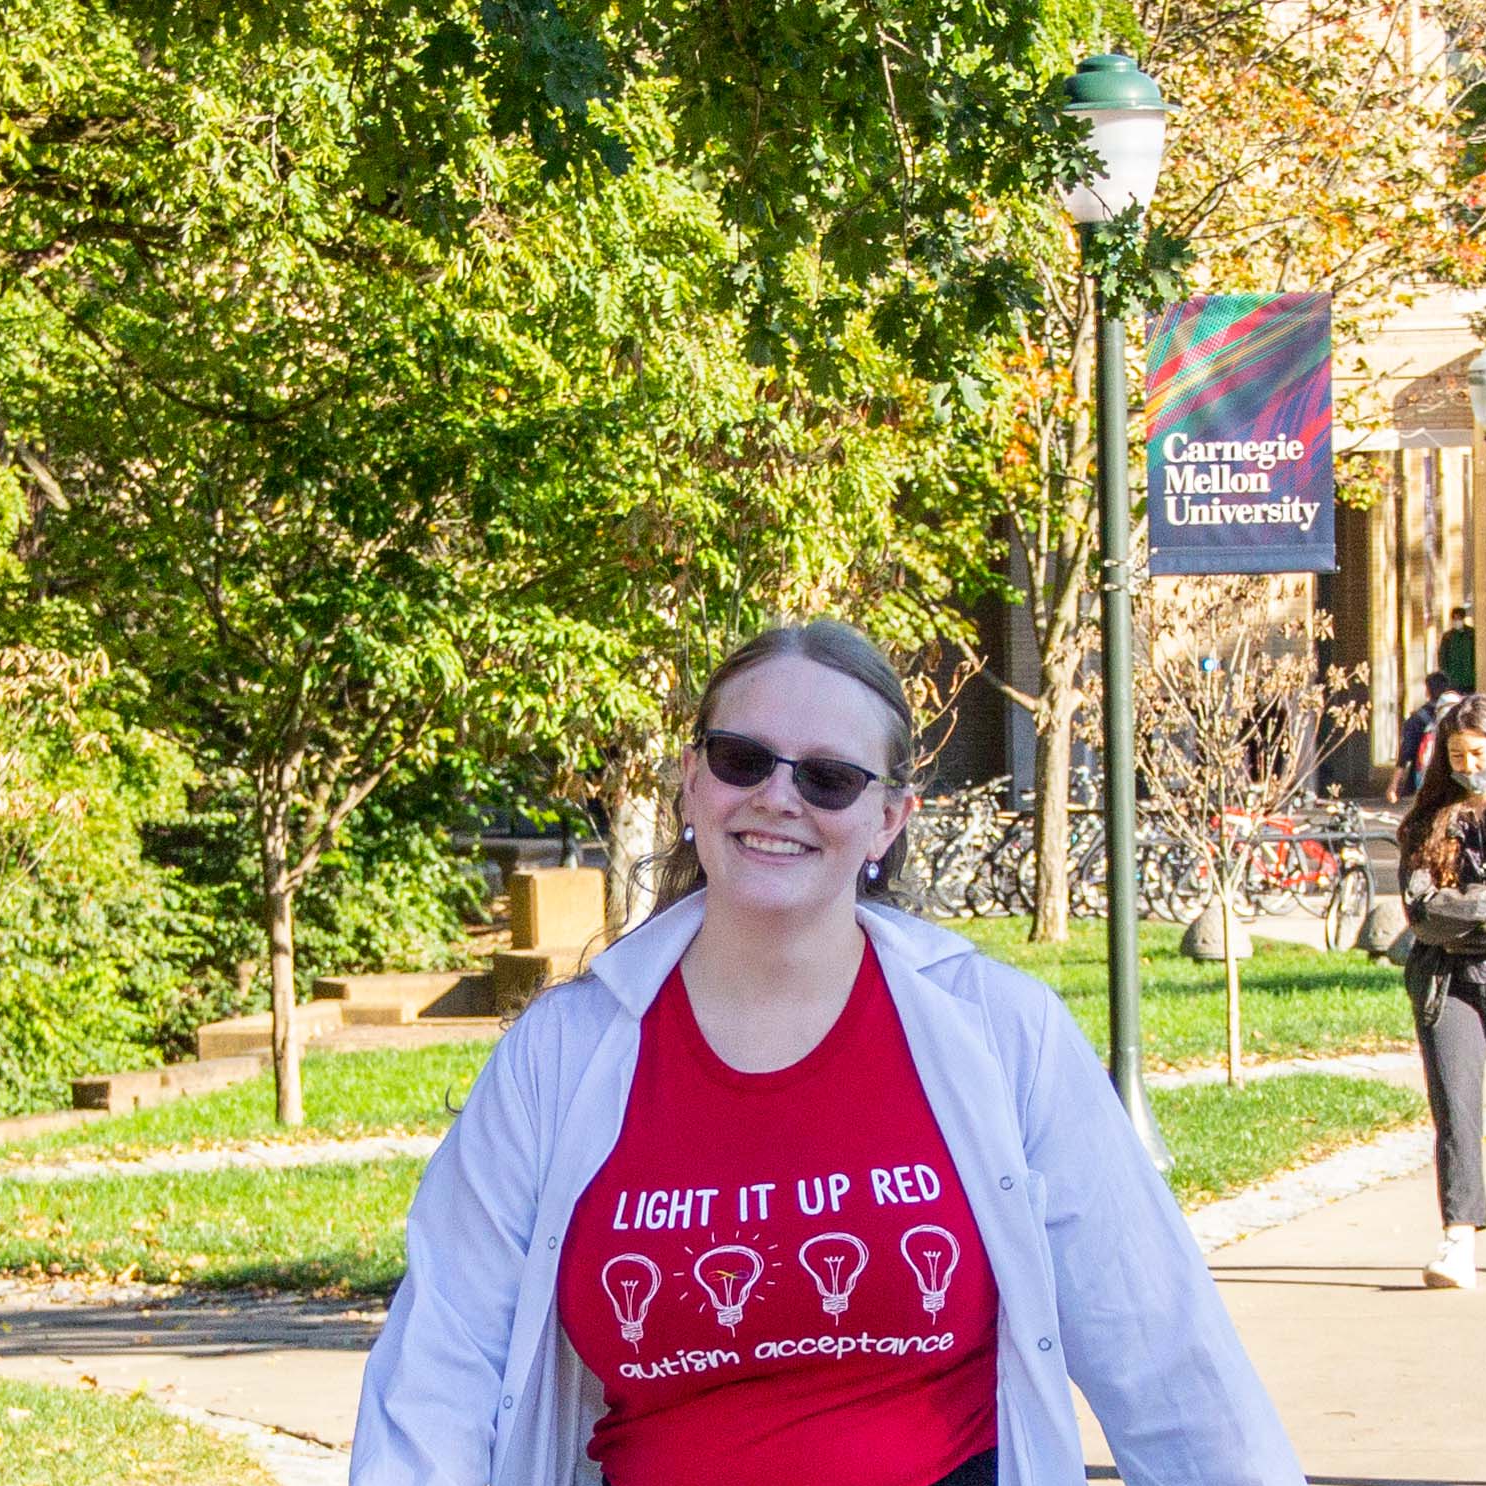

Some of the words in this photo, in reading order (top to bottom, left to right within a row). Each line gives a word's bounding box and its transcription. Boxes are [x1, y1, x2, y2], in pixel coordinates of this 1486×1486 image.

[1163, 432, 1304, 470] Carnegie
[1164, 464, 1272, 494] Mellon
[1165, 495, 1320, 531] University
[613, 1188, 719, 1230] LIGHT
[740, 1183, 776, 1222] IT
[798, 1173, 851, 1216] UP
[871, 1164, 941, 1205] RED
[619, 1348, 740, 1380] autism
[755, 1331, 954, 1360] acceptance
